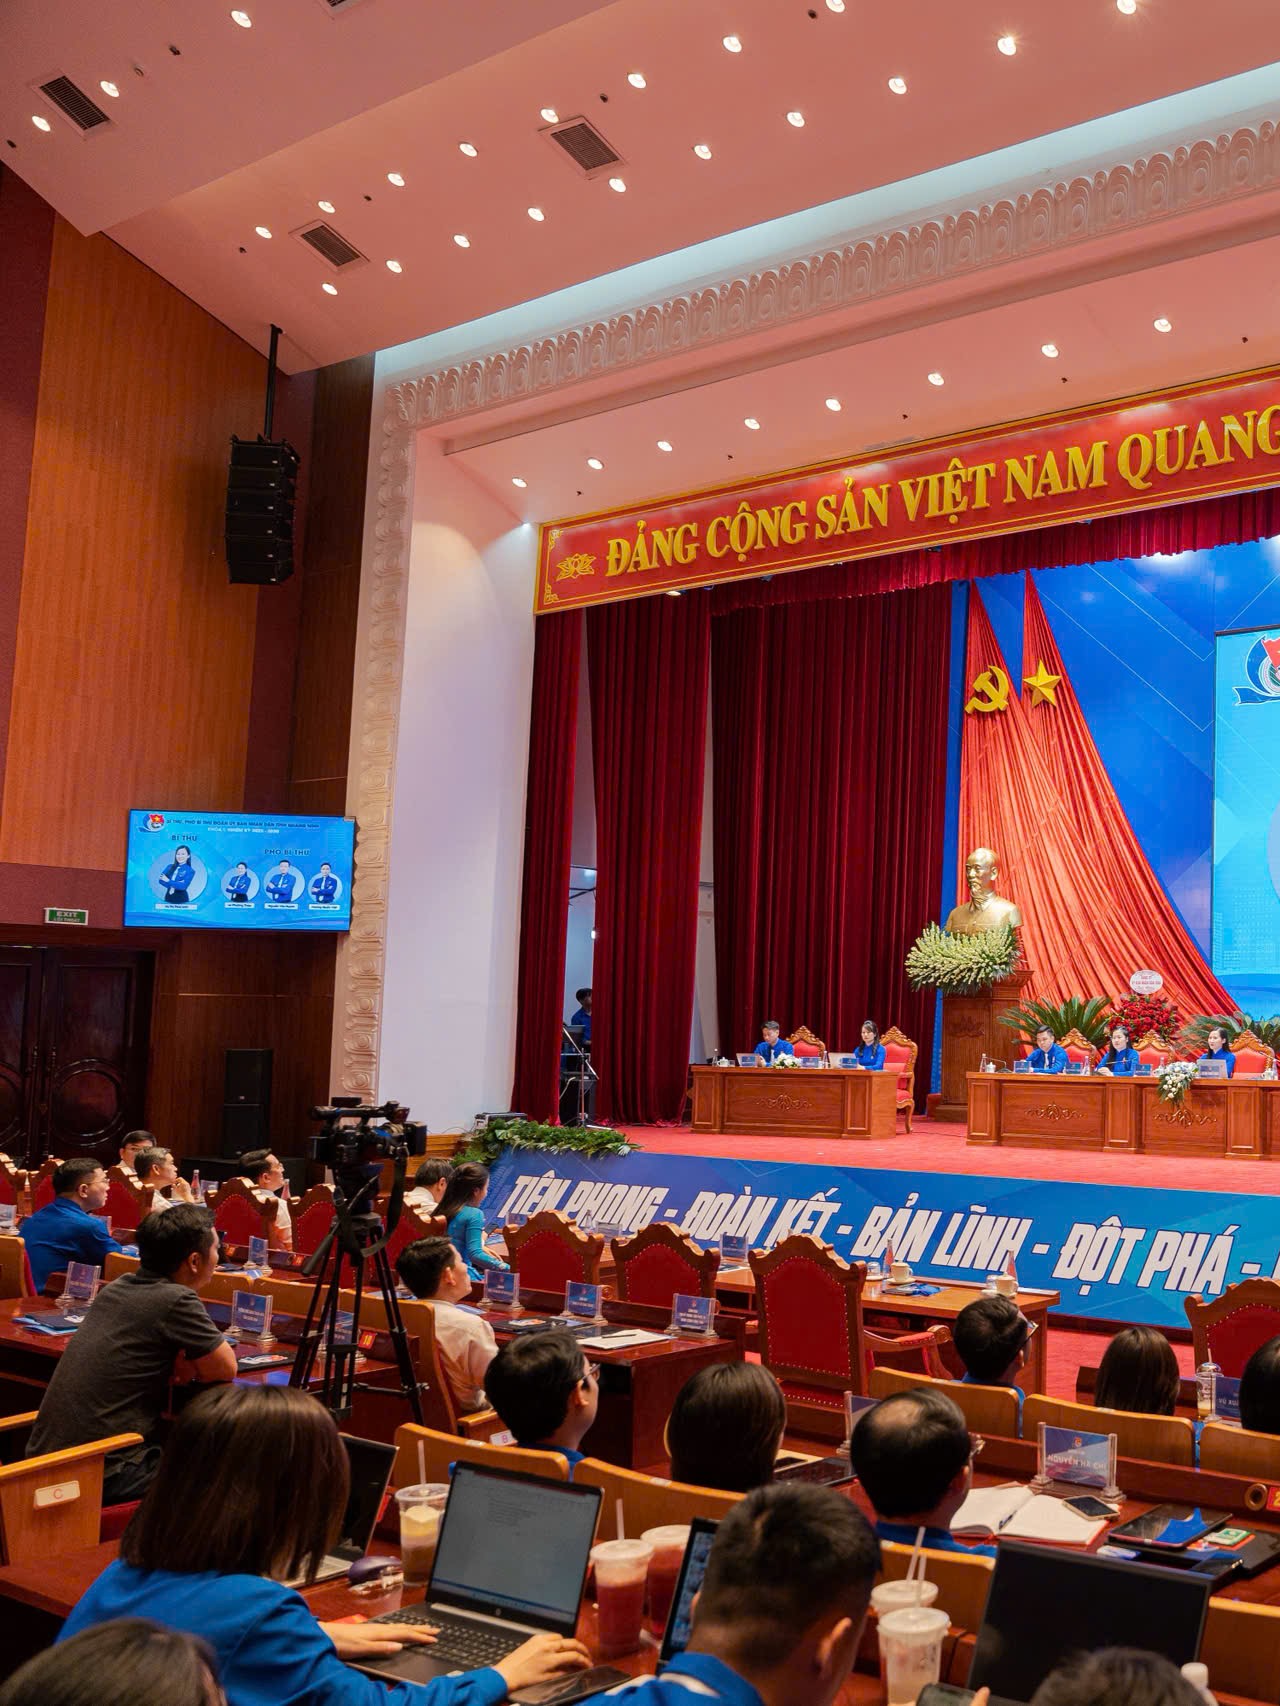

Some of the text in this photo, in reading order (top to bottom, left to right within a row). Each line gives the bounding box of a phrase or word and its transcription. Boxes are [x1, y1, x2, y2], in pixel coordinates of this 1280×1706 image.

[605, 519, 698, 578] ĐẢNG
[705, 502, 806, 563] CỘNG
[815, 475, 892, 540] SẢN
[899, 456, 996, 525] VIỆT
[1002, 440, 1108, 504] NAM
[564, 1180, 670, 1233] PHONG
[663, 1208, 679, 1219] -
[683, 1185, 771, 1245] ĐOÀN
[836, 1225, 854, 1235] -
[850, 1192, 943, 1263] BẢN
[930, 1204, 1034, 1272] LĨNH
[1032, 1243, 1049, 1254] -
[1052, 1215, 1146, 1296] ĐỘT
[1137, 1224, 1240, 1296] PHÁ
[1241, 1261, 1263, 1276] -
